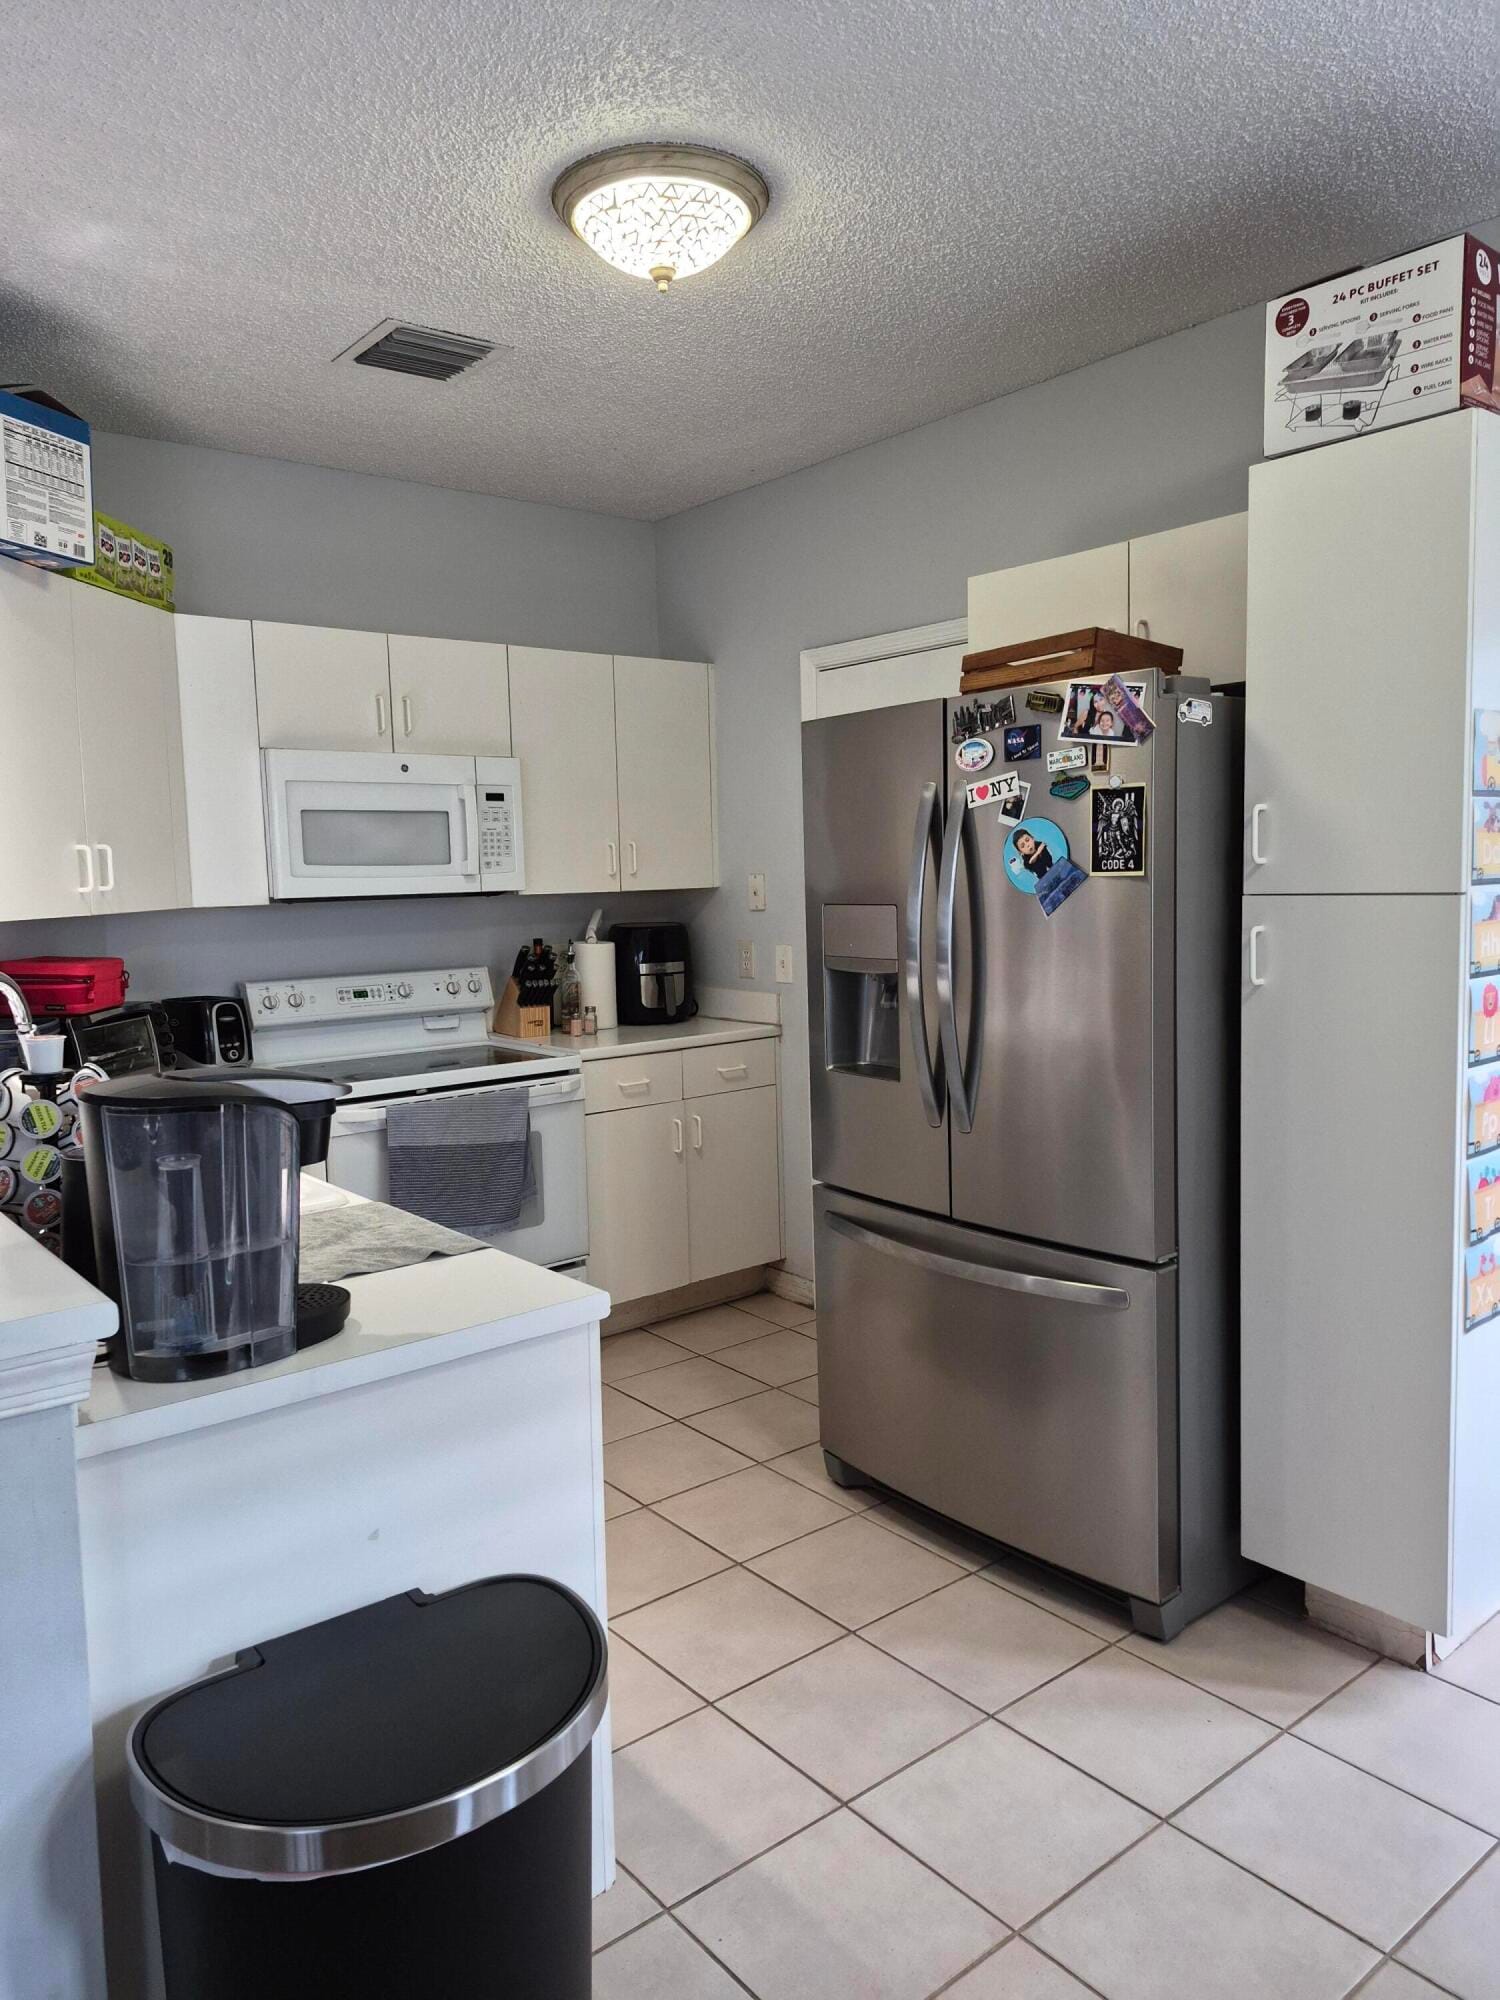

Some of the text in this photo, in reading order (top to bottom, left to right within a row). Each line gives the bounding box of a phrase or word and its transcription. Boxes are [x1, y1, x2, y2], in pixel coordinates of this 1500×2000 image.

[1478, 253, 1489, 270] 24
[1332, 259, 1441, 304] 24 PC BUFFET SET
[1360, 297, 1369, 305] KIT
[1379, 306, 1402, 318] SERVING
[1402, 300, 1420, 310] FORKS
[1421, 310, 1439, 320] FOOD
[1439, 305, 1454, 315] PANS
[1287, 314, 1295, 326] 3
[1420, 360, 1434, 369] WIRE
[1434, 356, 1453, 366] RACKS
[1423, 383, 1437, 391] FUEL
[1437, 378, 1453, 387] CANS
[101, 539, 114, 554] POP
[119, 551, 131, 563] POP
[134, 552, 147, 568] POP
[150, 562, 161, 573] POP
[1007, 736, 1025, 745] NASA
[968, 776, 1017, 804] I NY
[1101, 859, 1135, 870] CODE 4
